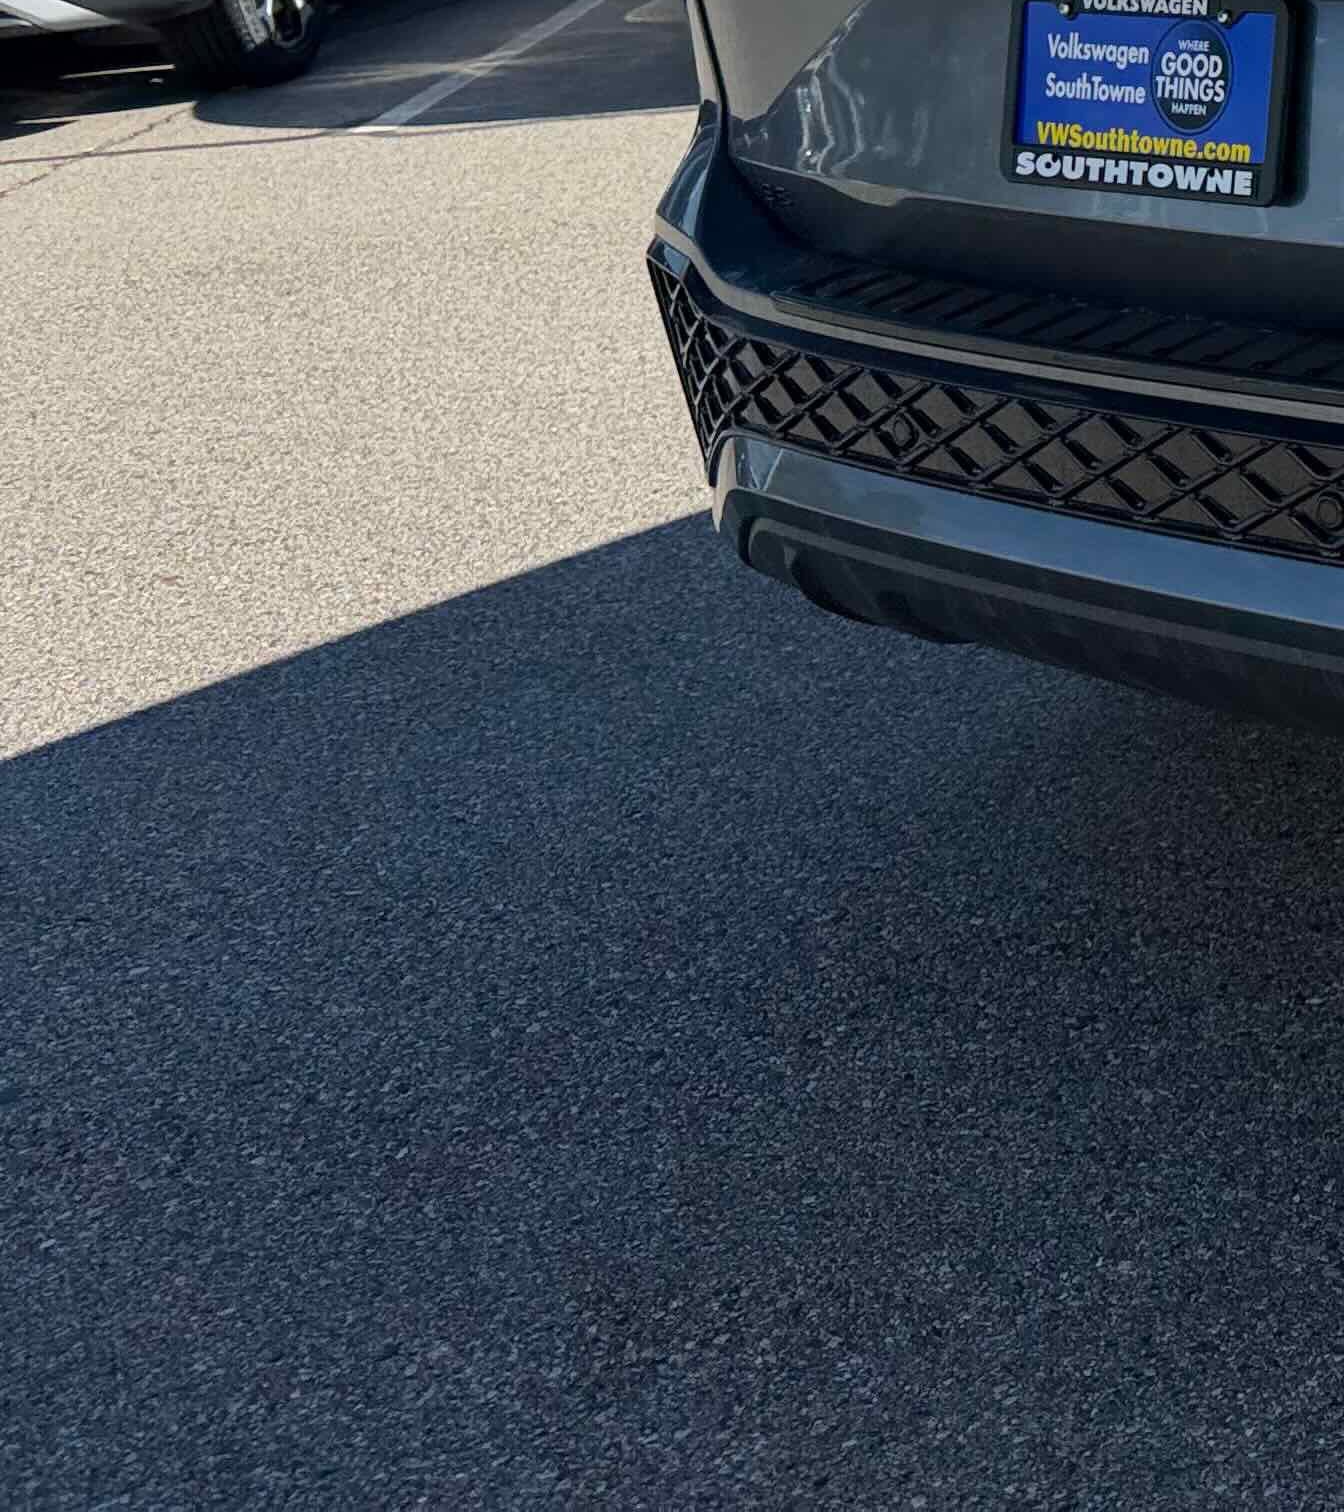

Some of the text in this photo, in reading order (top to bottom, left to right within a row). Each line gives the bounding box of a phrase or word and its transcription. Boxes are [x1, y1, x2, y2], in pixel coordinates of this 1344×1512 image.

[1047, 33, 1150, 70] Volkswagen
[1177, 39, 1210, 53] WHERE
[1160, 51, 1223, 79] GOOD
[1045, 72, 1146, 104] SouthTowne
[1155, 75, 1225, 103] THINGS
[1171, 102, 1208, 116] HAPPEN
[1036, 121, 1251, 163] VWSouthtowne.com
[1015, 151, 1253, 196] SOUTHTOWNE
